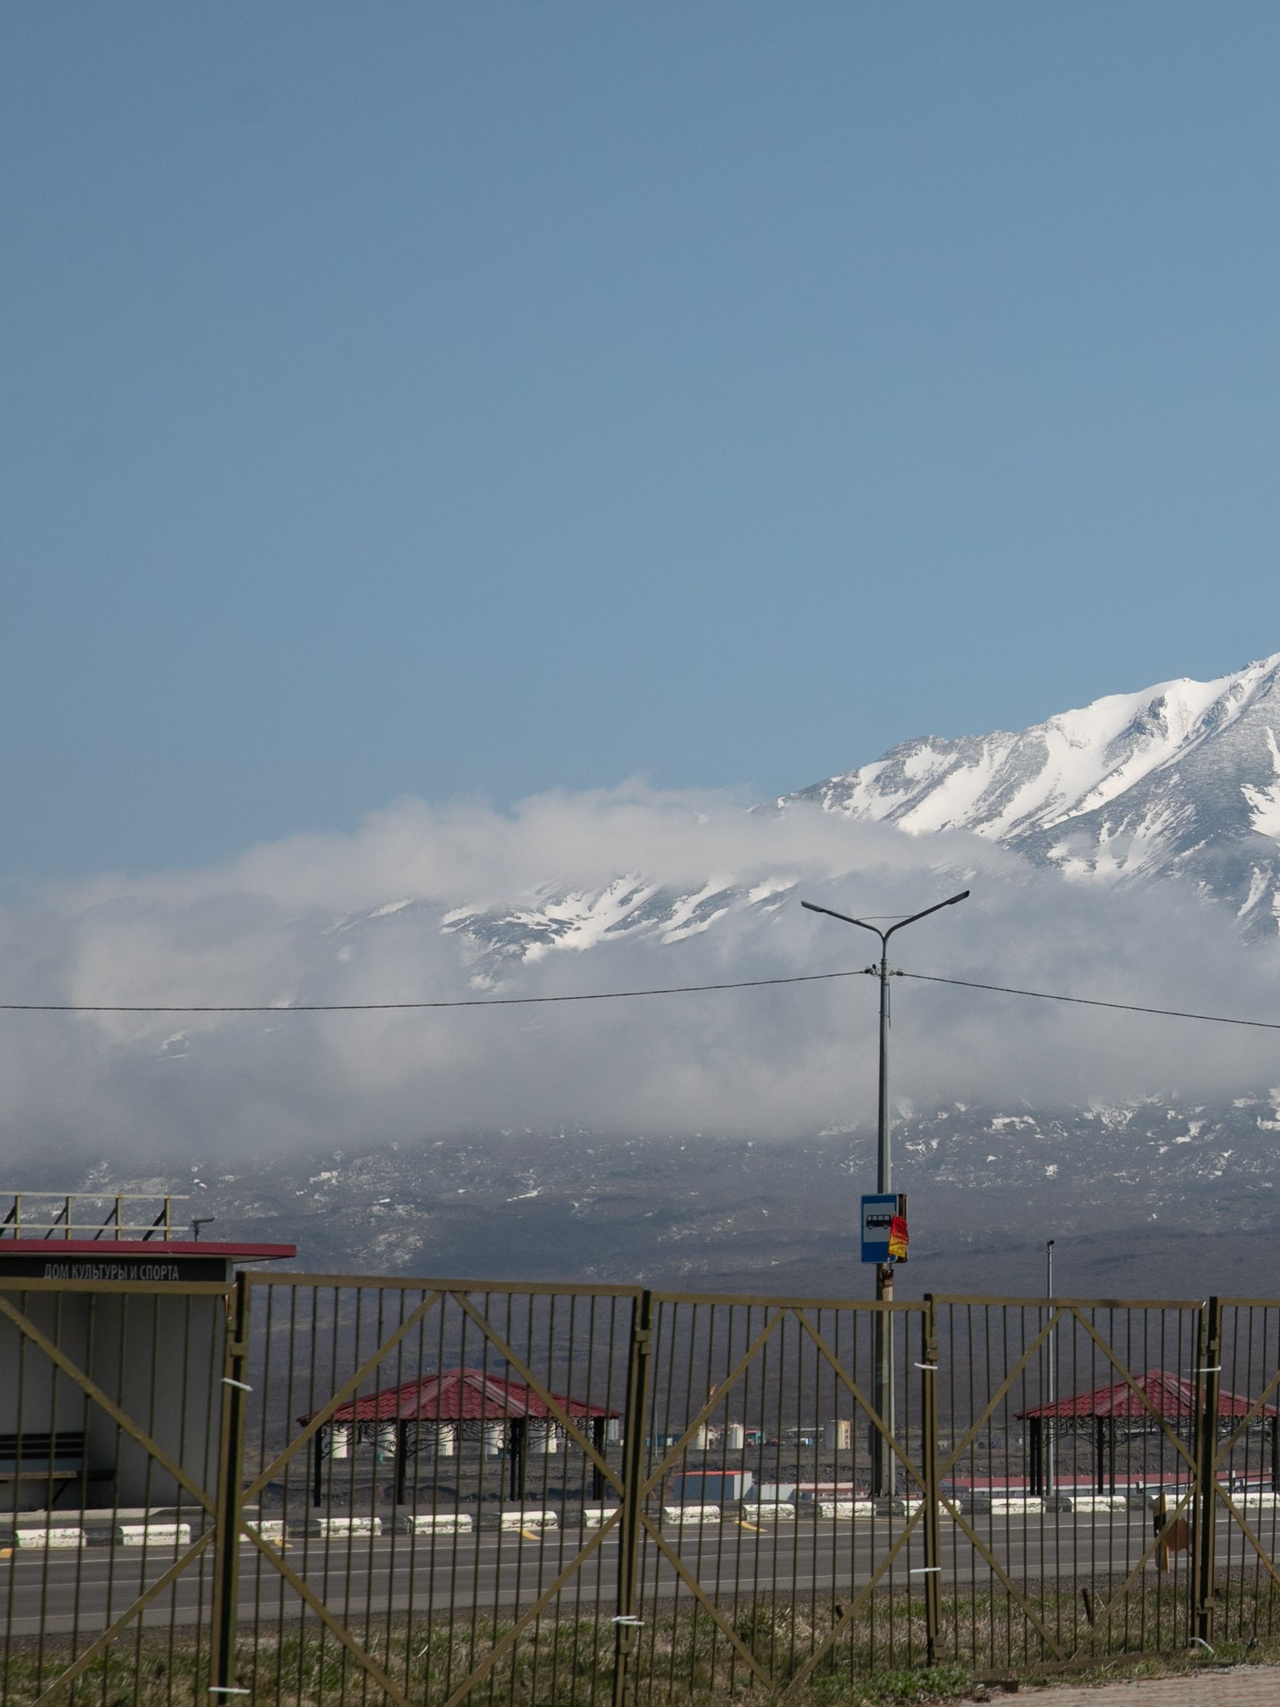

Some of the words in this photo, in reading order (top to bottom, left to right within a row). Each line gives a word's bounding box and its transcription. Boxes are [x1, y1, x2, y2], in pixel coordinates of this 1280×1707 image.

[44, 1264, 69, 1279] ДОМ
[72, 1264, 127, 1280] КУЛЬТУРЫ
[130, 1265, 138, 1280] И
[140, 1264, 180, 1280] СПОРТА
